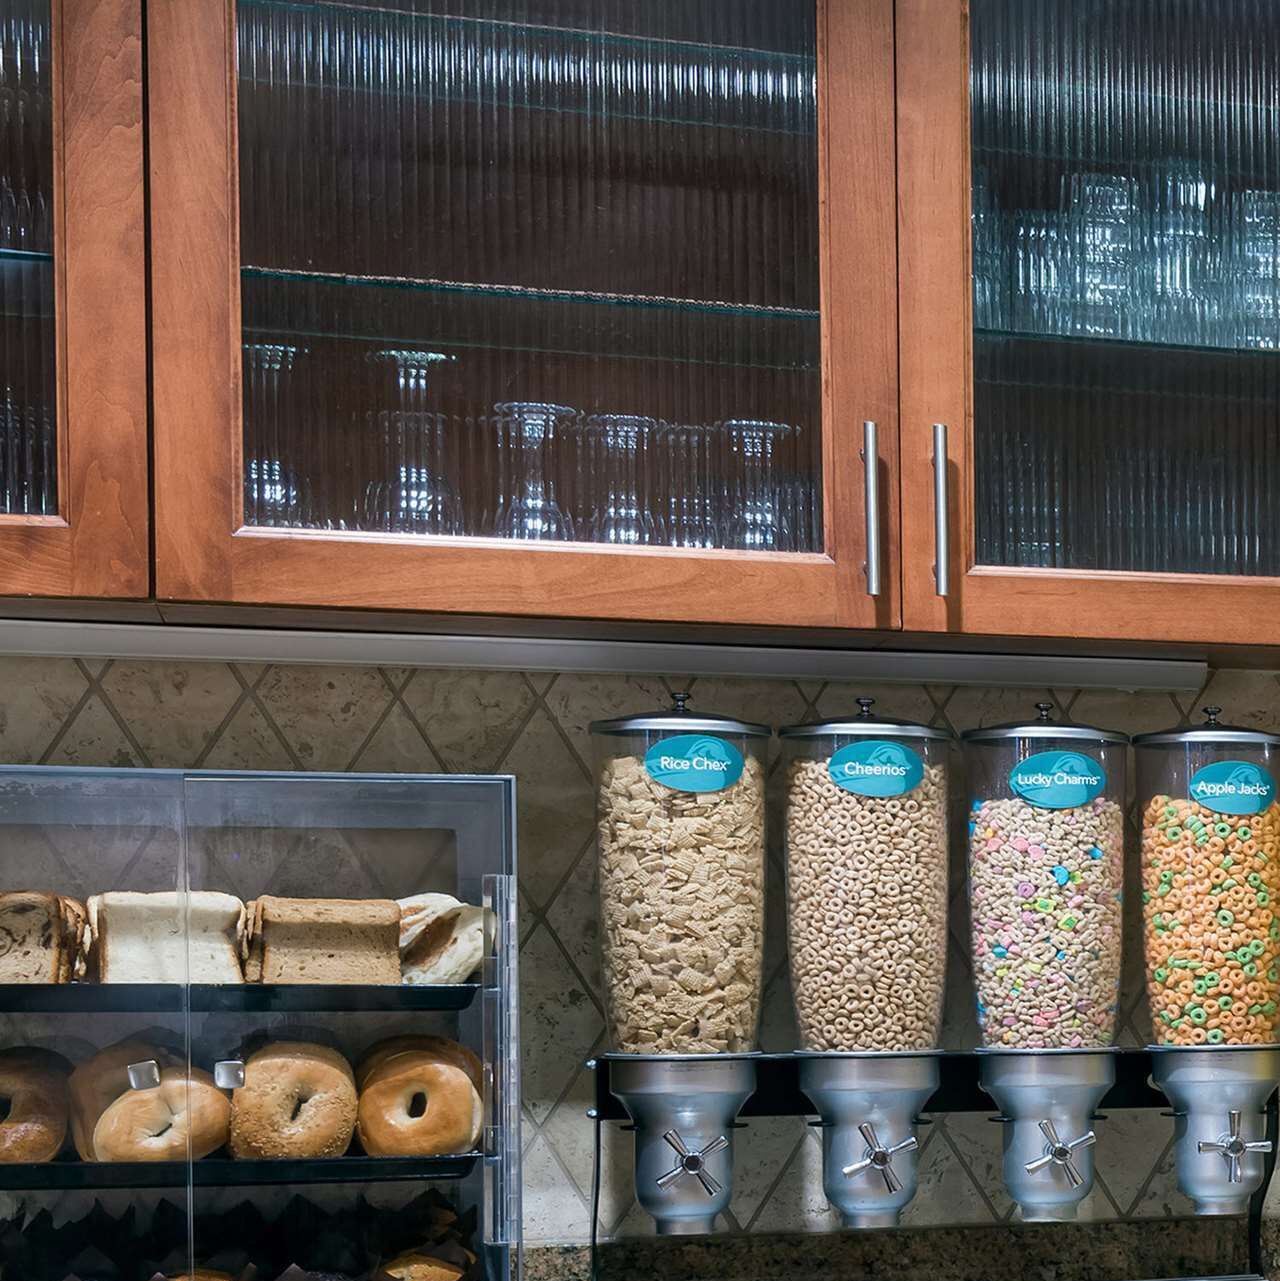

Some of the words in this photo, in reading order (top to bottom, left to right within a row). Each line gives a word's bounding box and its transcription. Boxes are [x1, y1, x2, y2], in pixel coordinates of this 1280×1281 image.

[660, 756, 690, 770] Rice
[1018, 772, 1053, 787] Lucky
[1197, 781, 1236, 796] Apple
